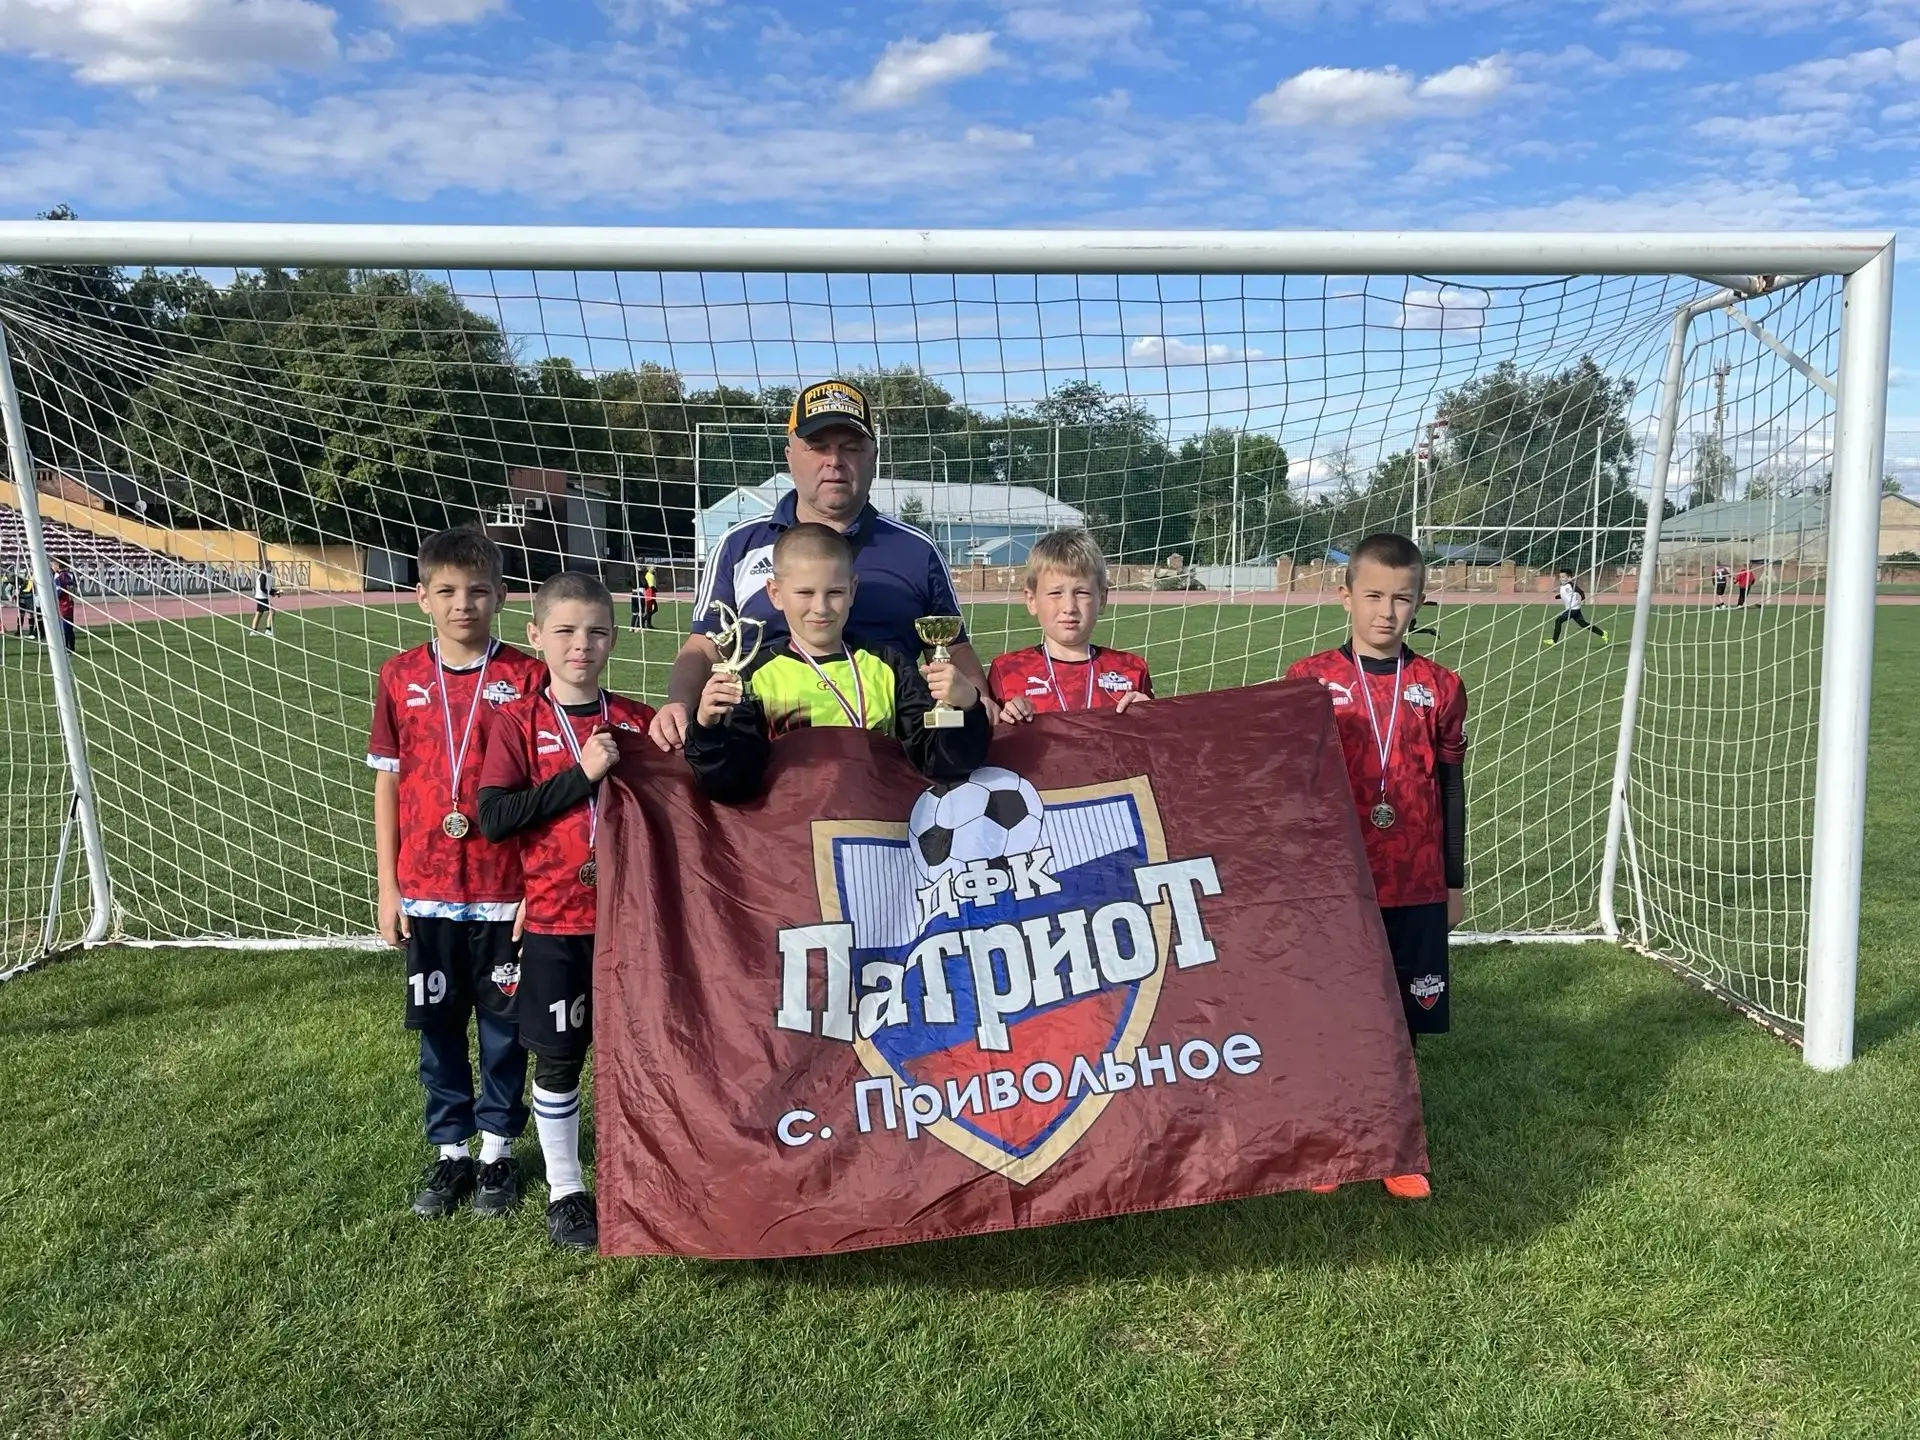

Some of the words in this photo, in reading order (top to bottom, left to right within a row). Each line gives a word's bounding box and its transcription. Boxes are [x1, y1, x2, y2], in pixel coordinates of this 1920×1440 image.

[750, 567, 774, 575] adida
[1025, 687, 1048, 696] PUMA
[916, 847, 1062, 937] ДФК
[408, 970, 447, 1006] 19
[549, 994, 586, 1032] 16
[776, 1109, 833, 1147] с.
[854, 1033, 1263, 1141] Привольное
